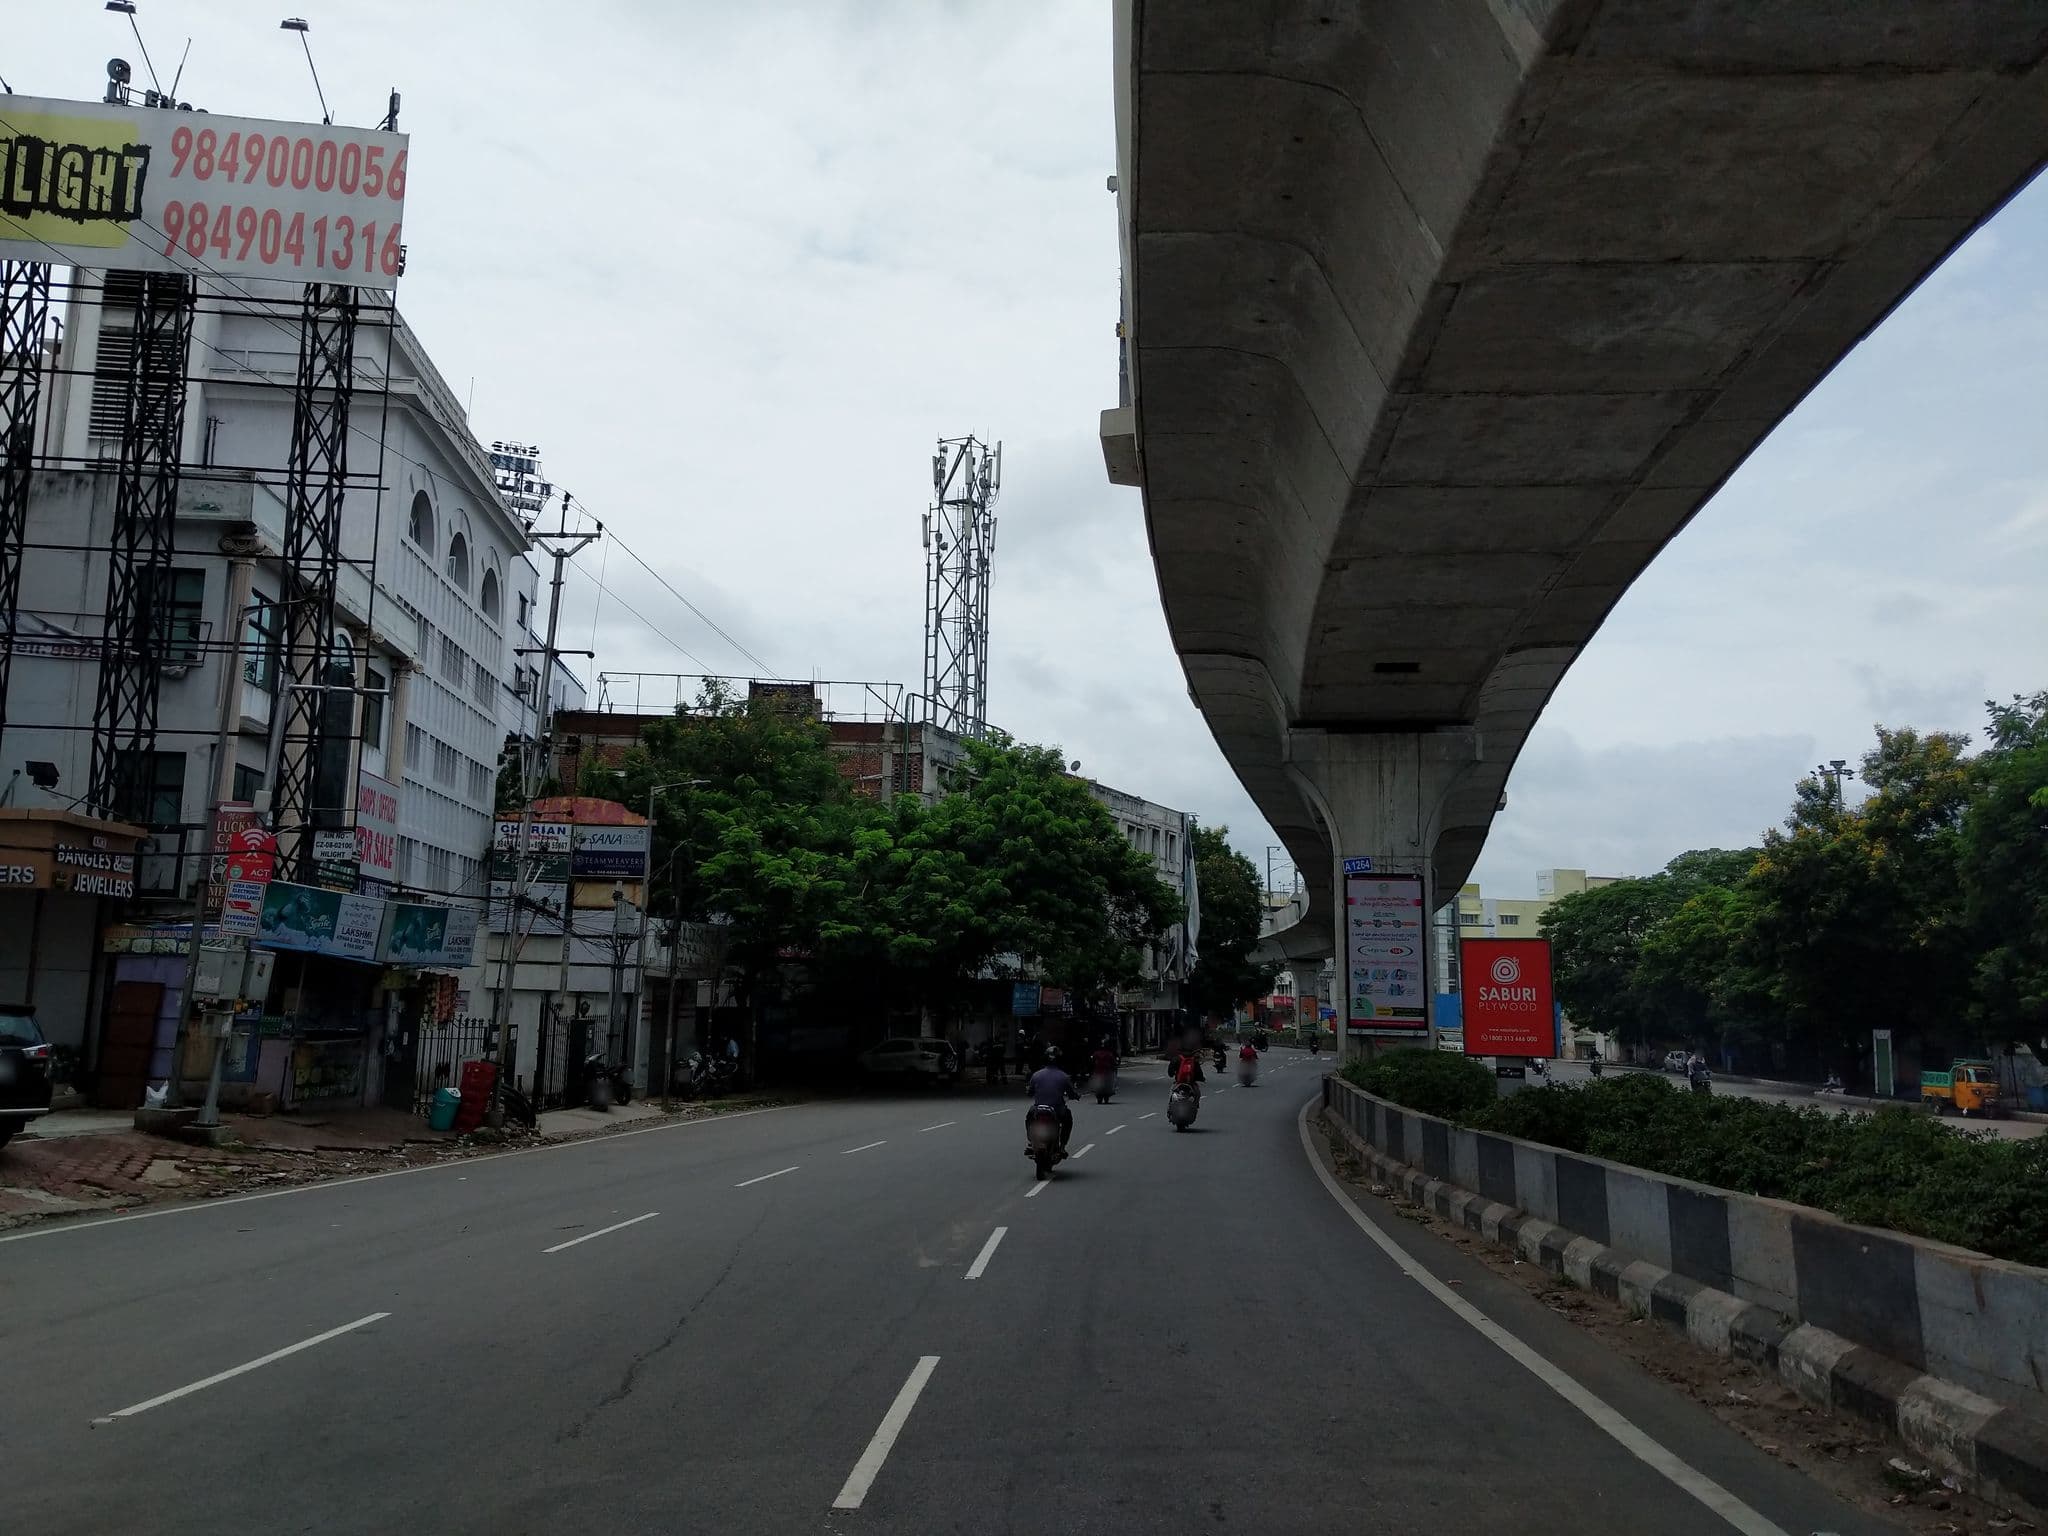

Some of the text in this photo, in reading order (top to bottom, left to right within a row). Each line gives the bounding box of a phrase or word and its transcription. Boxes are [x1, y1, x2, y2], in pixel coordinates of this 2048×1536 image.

[169, 126, 407, 201] 9849000056
[162, 200, 402, 276] 9849041316
[500, 824, 566, 836] CHRIAN
[591, 833, 623, 845] SANA
[57, 844, 111, 870] BANGLES
[320, 850, 346, 858] HILIGHT
[374, 832, 394, 869] SALE
[250, 867, 271, 878] ACT
[1345, 860, 1370, 872] A 1264
[74, 873, 134, 900] JEWELLERS
[341, 926, 373, 939] LAKSHMI
[1479, 986, 1536, 1002] SABURI
[1479, 1002, 1537, 1012] PLYWOOD
